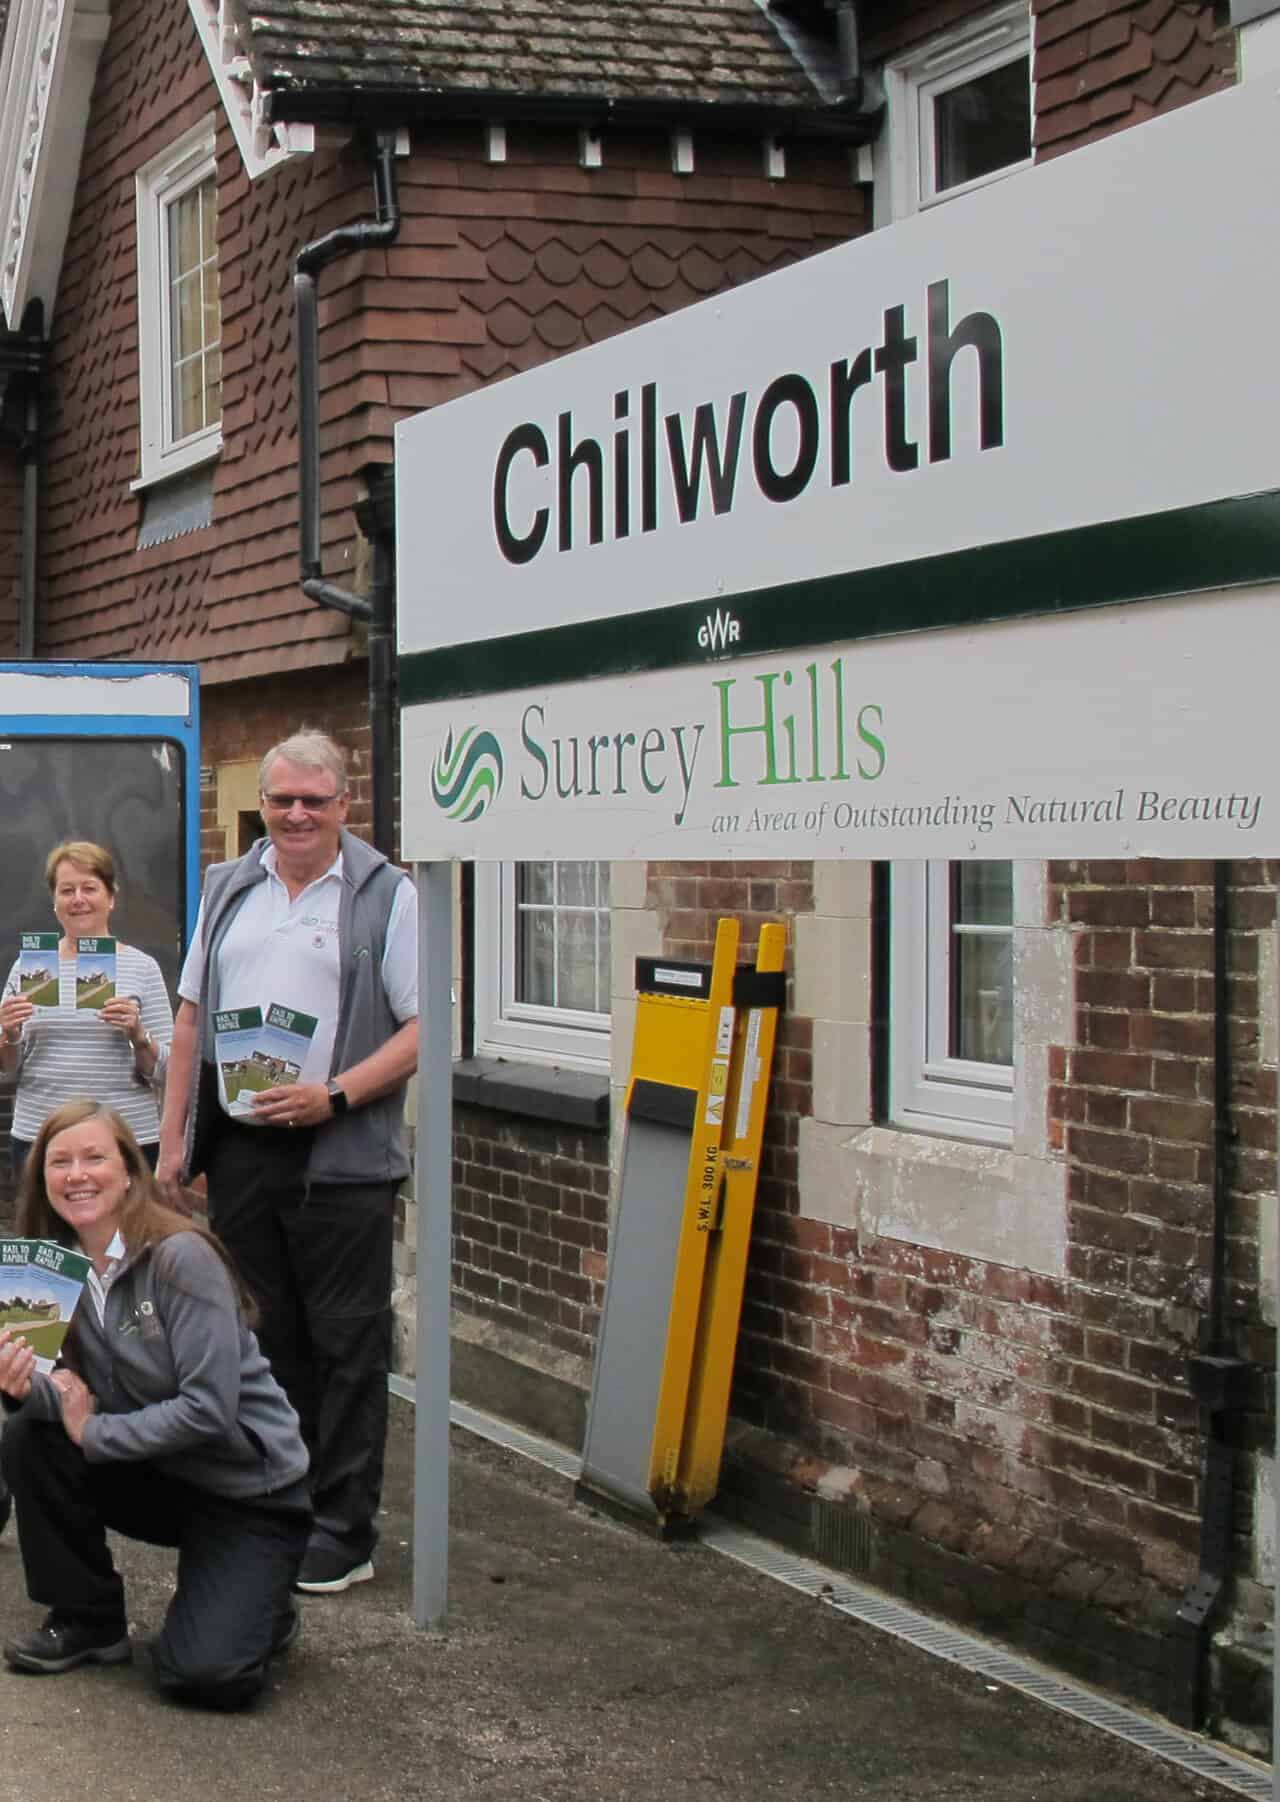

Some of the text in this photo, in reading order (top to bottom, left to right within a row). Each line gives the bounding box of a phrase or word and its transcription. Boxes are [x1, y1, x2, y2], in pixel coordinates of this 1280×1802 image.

[494, 278, 1004, 565] Chilworth
[697, 608, 741, 651] GWR
[520, 657, 887, 826] Surrey Hills
[711, 788, 1262, 837] an Area of Outstanding Natural Beauty
[705, 1145, 718, 1162] KG
